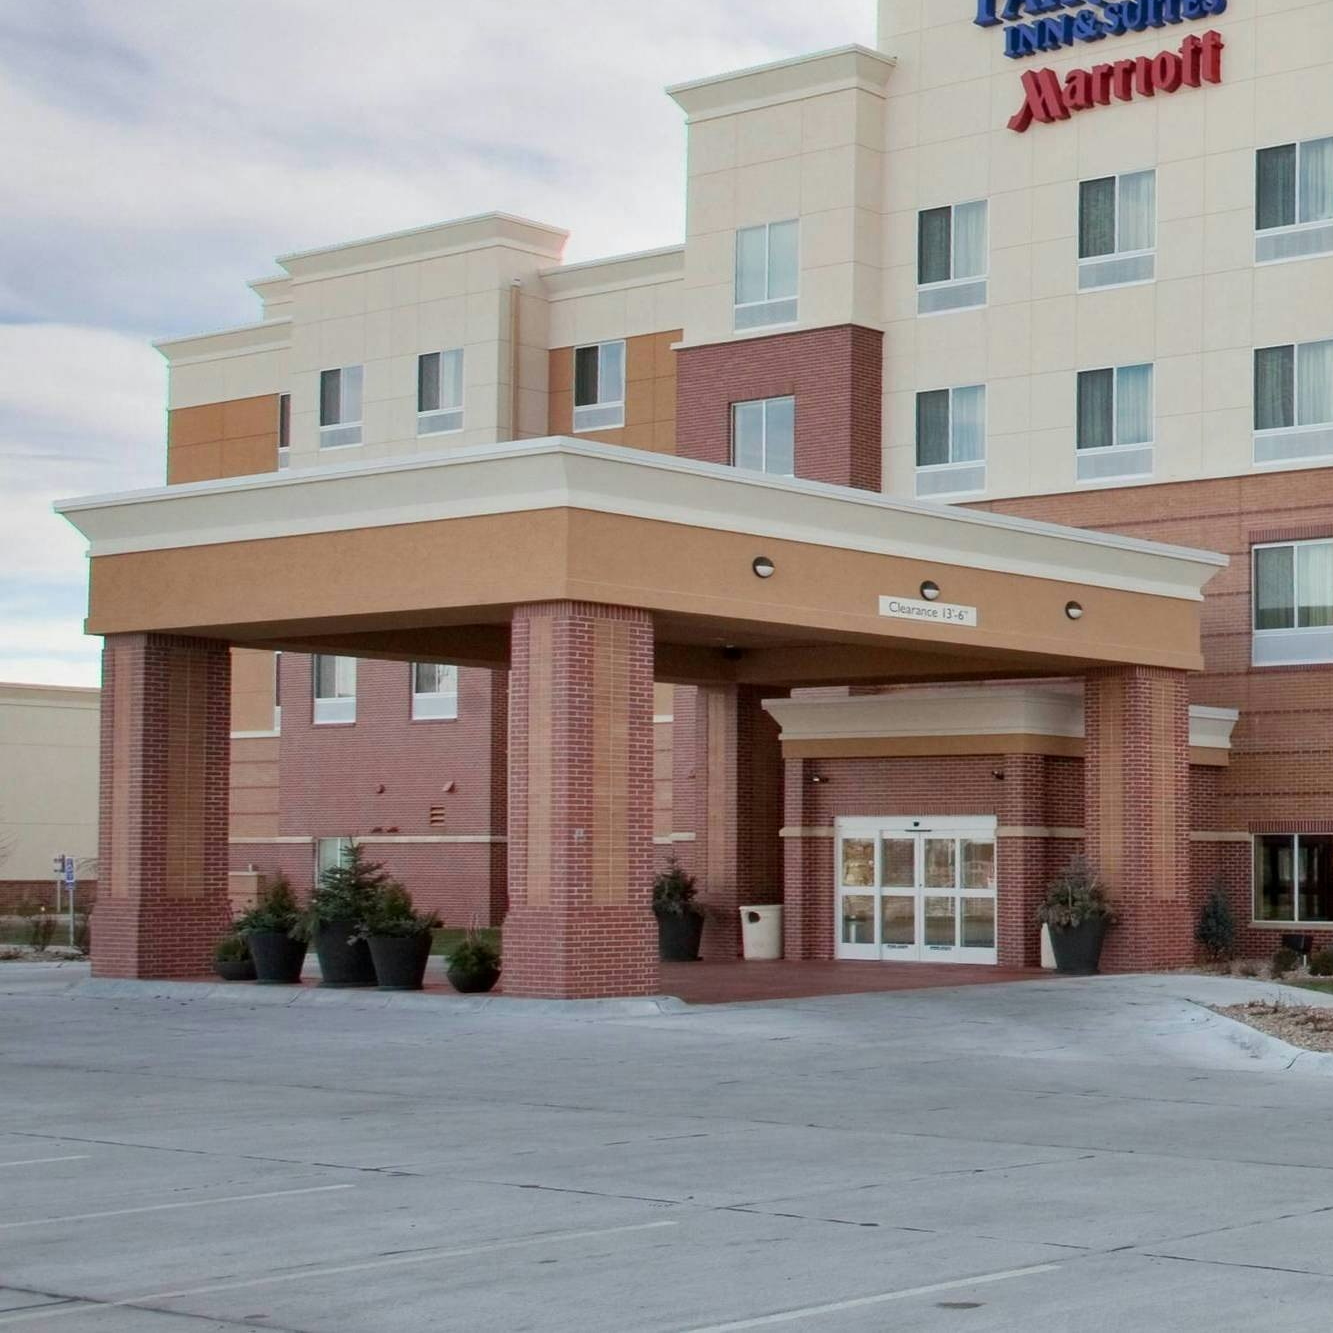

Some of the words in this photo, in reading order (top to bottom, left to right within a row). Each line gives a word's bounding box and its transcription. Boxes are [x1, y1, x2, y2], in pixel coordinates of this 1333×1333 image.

[1003, 14, 1074, 59] INN
[1072, 9, 1107, 42] &
[1007, 30, 1225, 133] Marriott
[888, 601, 938, 618] Clearance
